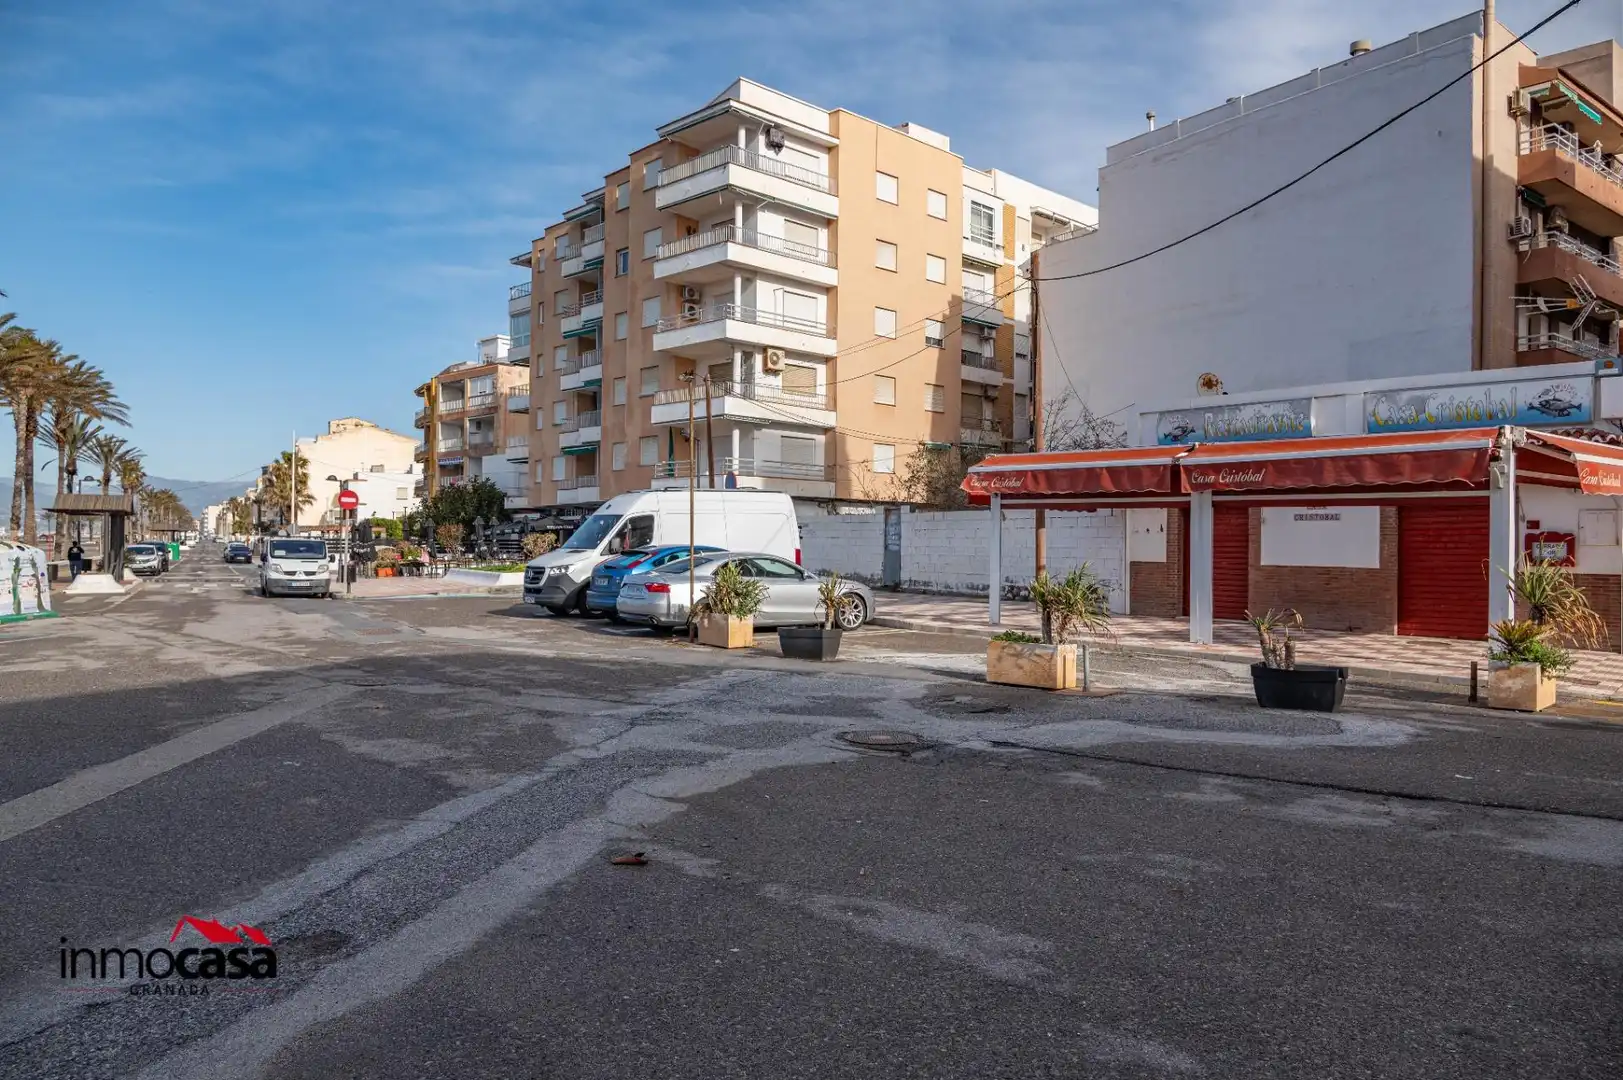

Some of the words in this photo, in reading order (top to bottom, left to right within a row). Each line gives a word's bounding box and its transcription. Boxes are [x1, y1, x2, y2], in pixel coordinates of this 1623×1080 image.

[1371, 395, 1420, 426] Casa
[1424, 386, 1518, 424] Cristobal
[1191, 470, 1215, 484] Casa
[1294, 513, 1341, 521] CRISTOBAL
